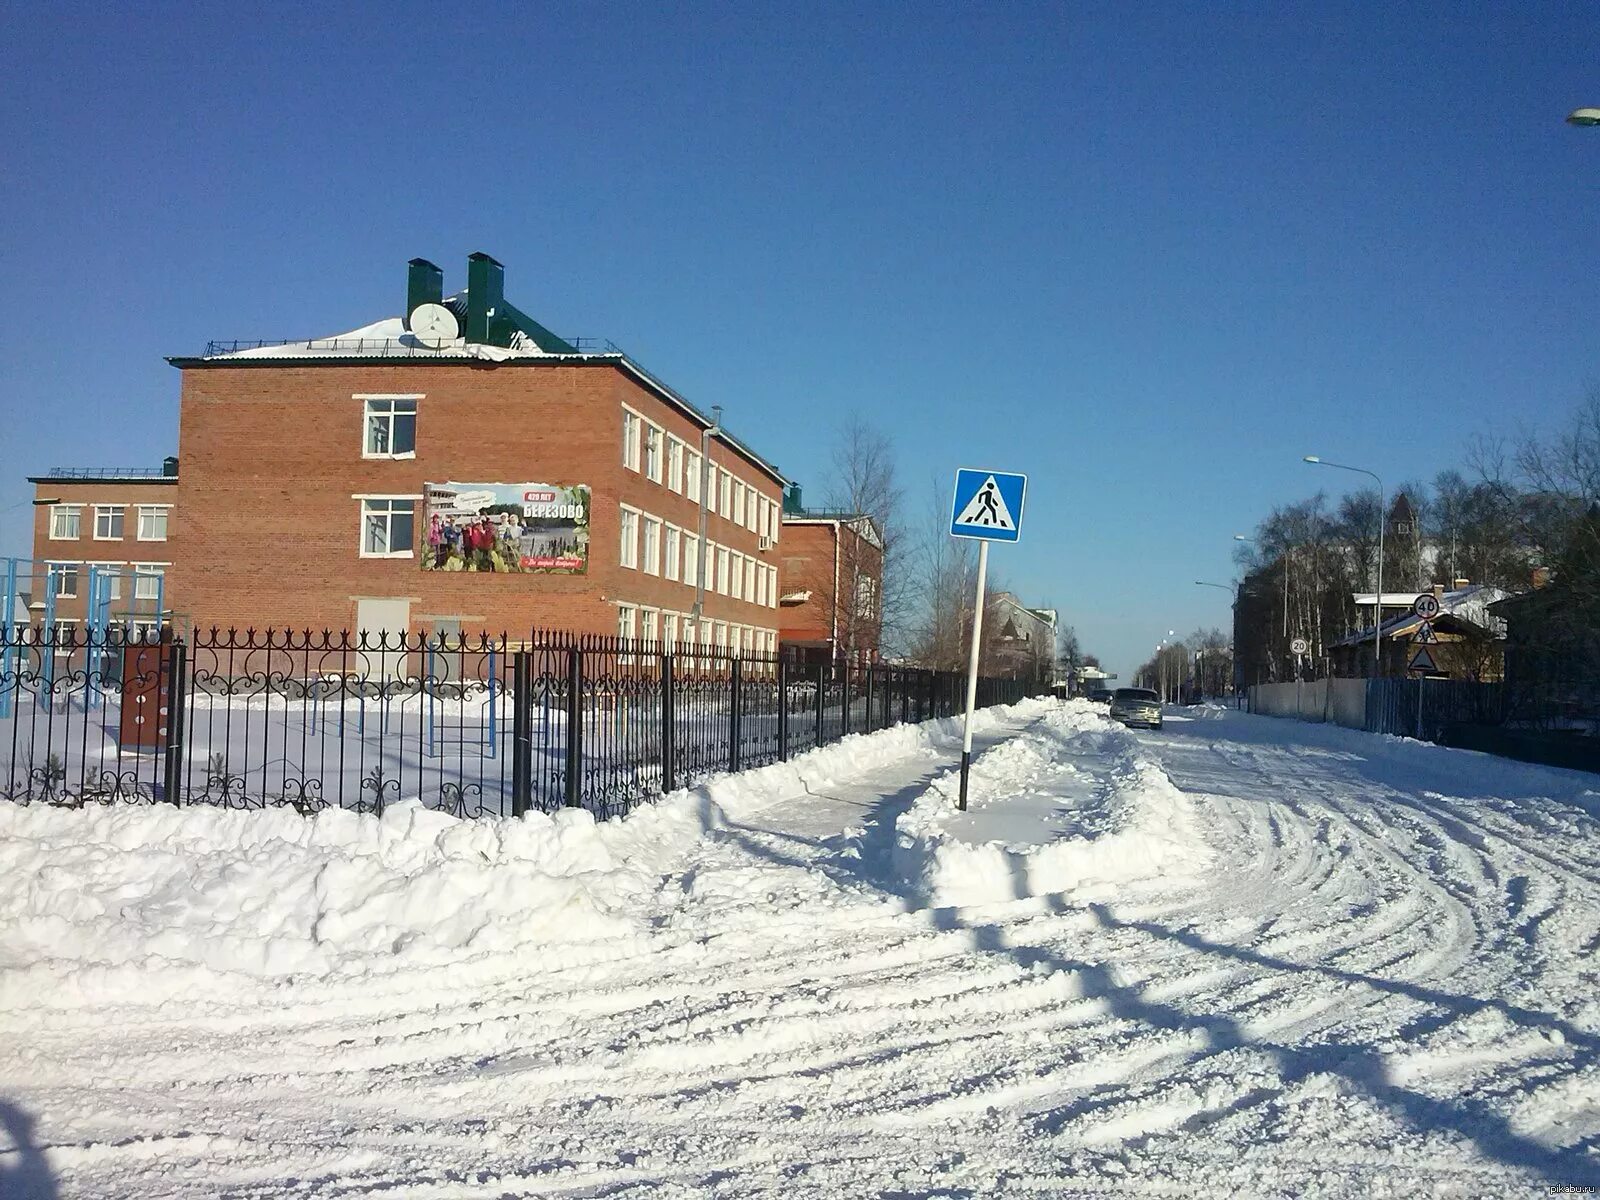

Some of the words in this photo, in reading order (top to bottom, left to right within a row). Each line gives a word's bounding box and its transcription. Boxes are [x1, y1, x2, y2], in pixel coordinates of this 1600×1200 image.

[540, 493, 552, 501] ЛЕТ
[523, 504, 584, 519] БЕРЕЗОВО
[1418, 601, 1435, 611] 40
[1293, 642, 1305, 650] 20
